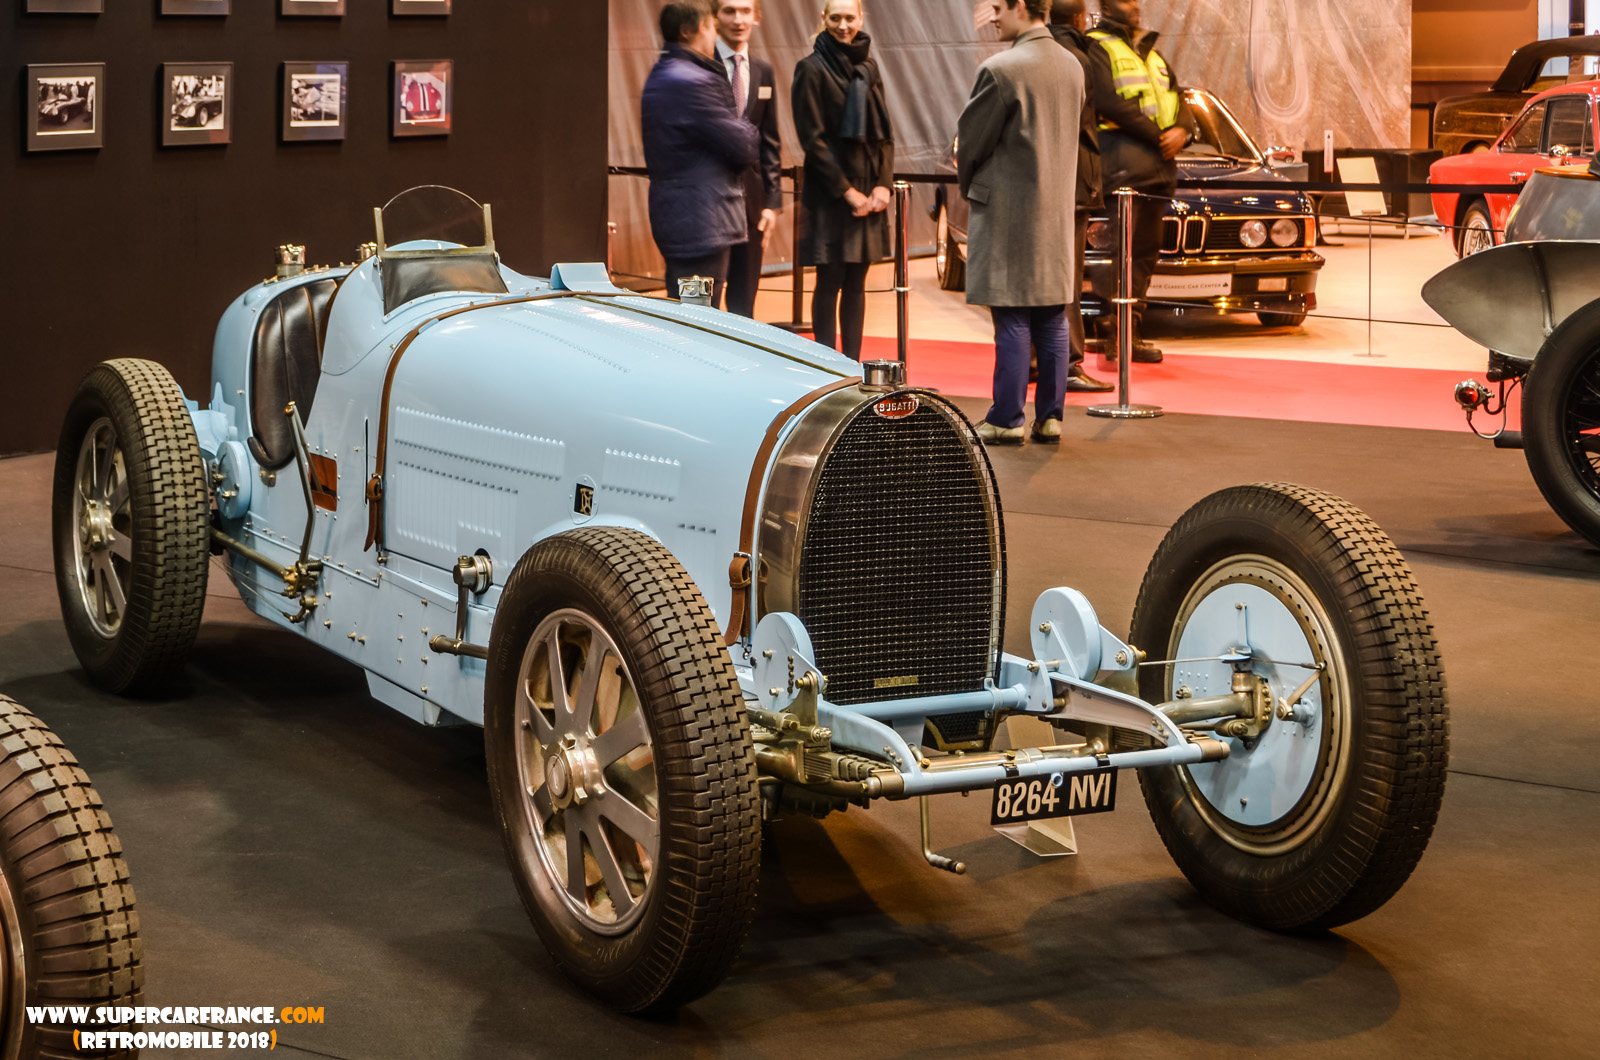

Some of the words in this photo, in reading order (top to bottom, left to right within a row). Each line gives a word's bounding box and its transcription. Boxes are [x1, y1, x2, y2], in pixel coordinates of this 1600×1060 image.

[879, 401, 915, 412] BUGATTI
[996, 778, 1060, 818] 8264
[1068, 772, 1112, 810] NVI
